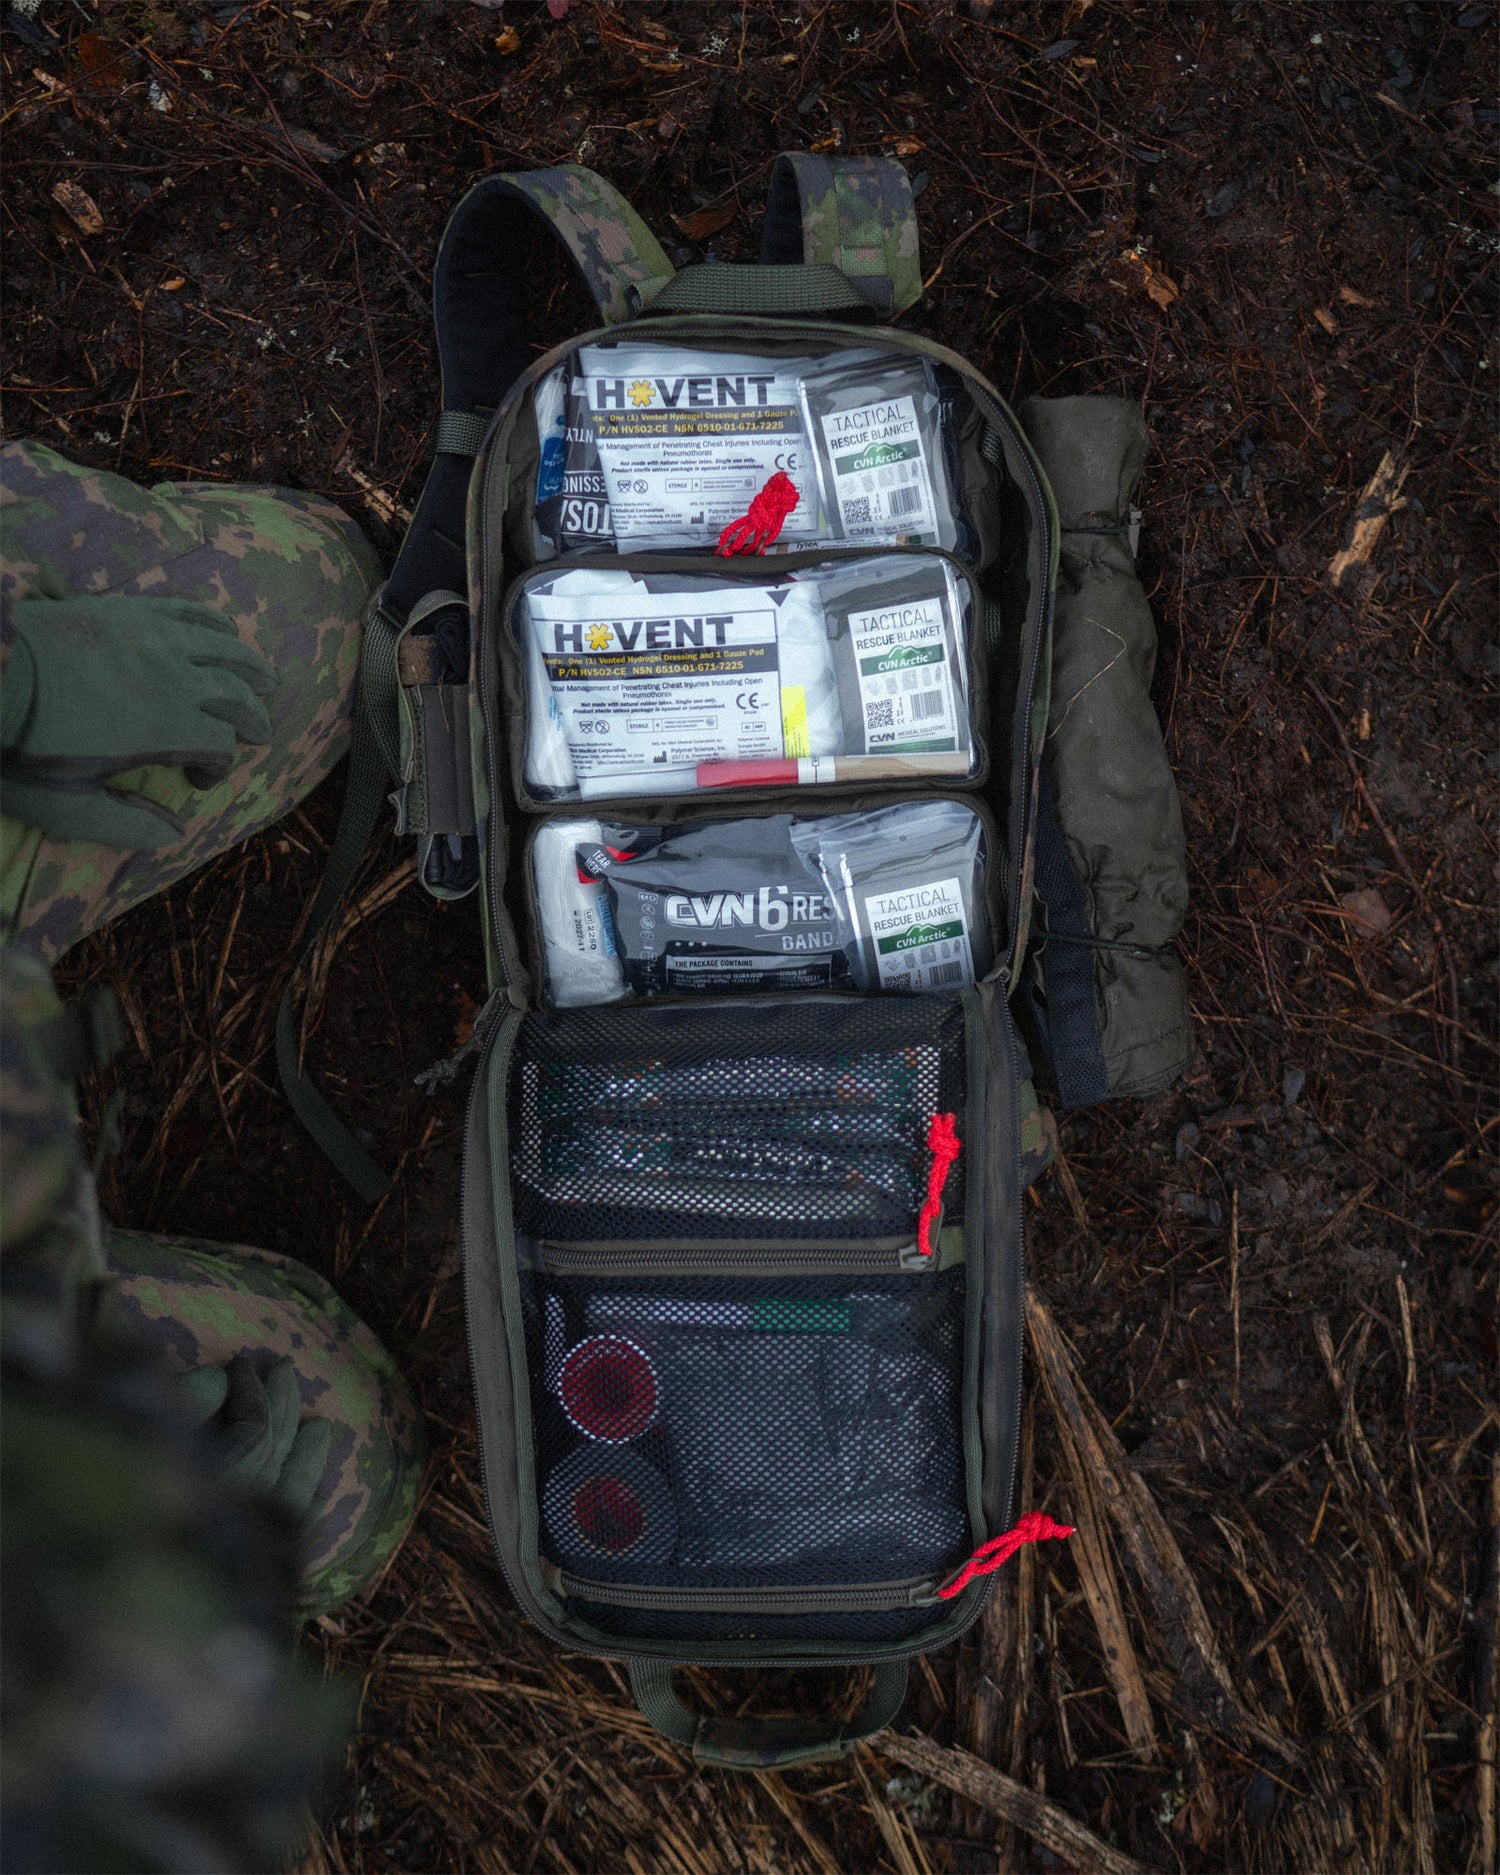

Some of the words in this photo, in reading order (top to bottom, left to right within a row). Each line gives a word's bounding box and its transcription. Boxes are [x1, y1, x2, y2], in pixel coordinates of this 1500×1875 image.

[609, 414, 625, 422] One
[641, 413, 668, 422] Vented
[669, 412, 704, 422] Hydrogel
[705, 411, 740, 420] Dressing
[741, 410, 756, 419] and
[764, 410, 788, 418] Gauze
[834, 404, 906, 432] TACTICAL
[599, 425, 619, 436] P/N
[674, 423, 695, 433] NSN
[697, 421, 784, 433] 6510-01-671-7225
[830, 432, 870, 450] RESCUE
[871, 421, 914, 441] BLANKET
[606, 442, 651, 451] Management
[662, 440, 701, 449] Penetrating
[703, 440, 723, 448] Chest
[725, 440, 750, 449] Injuries
[752, 439, 781, 447] Including
[663, 449, 713, 457] Pneumothorax
[854, 457, 873, 470] CVN
[875, 451, 904, 465] Arctic
[860, 607, 933, 633] TACTICAL
[856, 634, 895, 651] RESCUE
[897, 624, 941, 643] BLANKET
[585, 657, 597, 665] (1)
[600, 656, 626, 664] Vented
[627, 655, 662, 664] Hydrogel
[663, 653, 698, 662] Dressing
[699, 652, 714, 660] and
[723, 650, 747, 658] Gauze
[749, 648, 765, 656] Pad
[878, 660, 898, 671] CVN
[900, 654, 929, 667] Arctic
[559, 668, 579, 678] P/N
[632, 666, 653, 675] NSN
[655, 661, 744, 675] 6510-01-671-7225
[567, 685, 611, 693] Management
[621, 683, 661, 692] Penetrating
[662, 682, 683, 690] Chest
[684, 681, 710, 690] Injuries
[712, 679, 743, 687] Including
[744, 678, 763, 686] Open
[869, 732, 895, 743] CVN
[585, 857, 603, 875] HERE
[592, 849, 611, 869] TEAR
[876, 887, 951, 914] TACTICAL
[665, 893, 755, 929] CVN
[874, 914, 913, 931] RESCUE
[915, 902, 959, 922] BLANKET
[896, 936, 917, 949] CVN
[918, 930, 947, 943] Arctic
[689, 960, 718, 968] PACKAGE
[720, 959, 753, 967] CONTAINS
